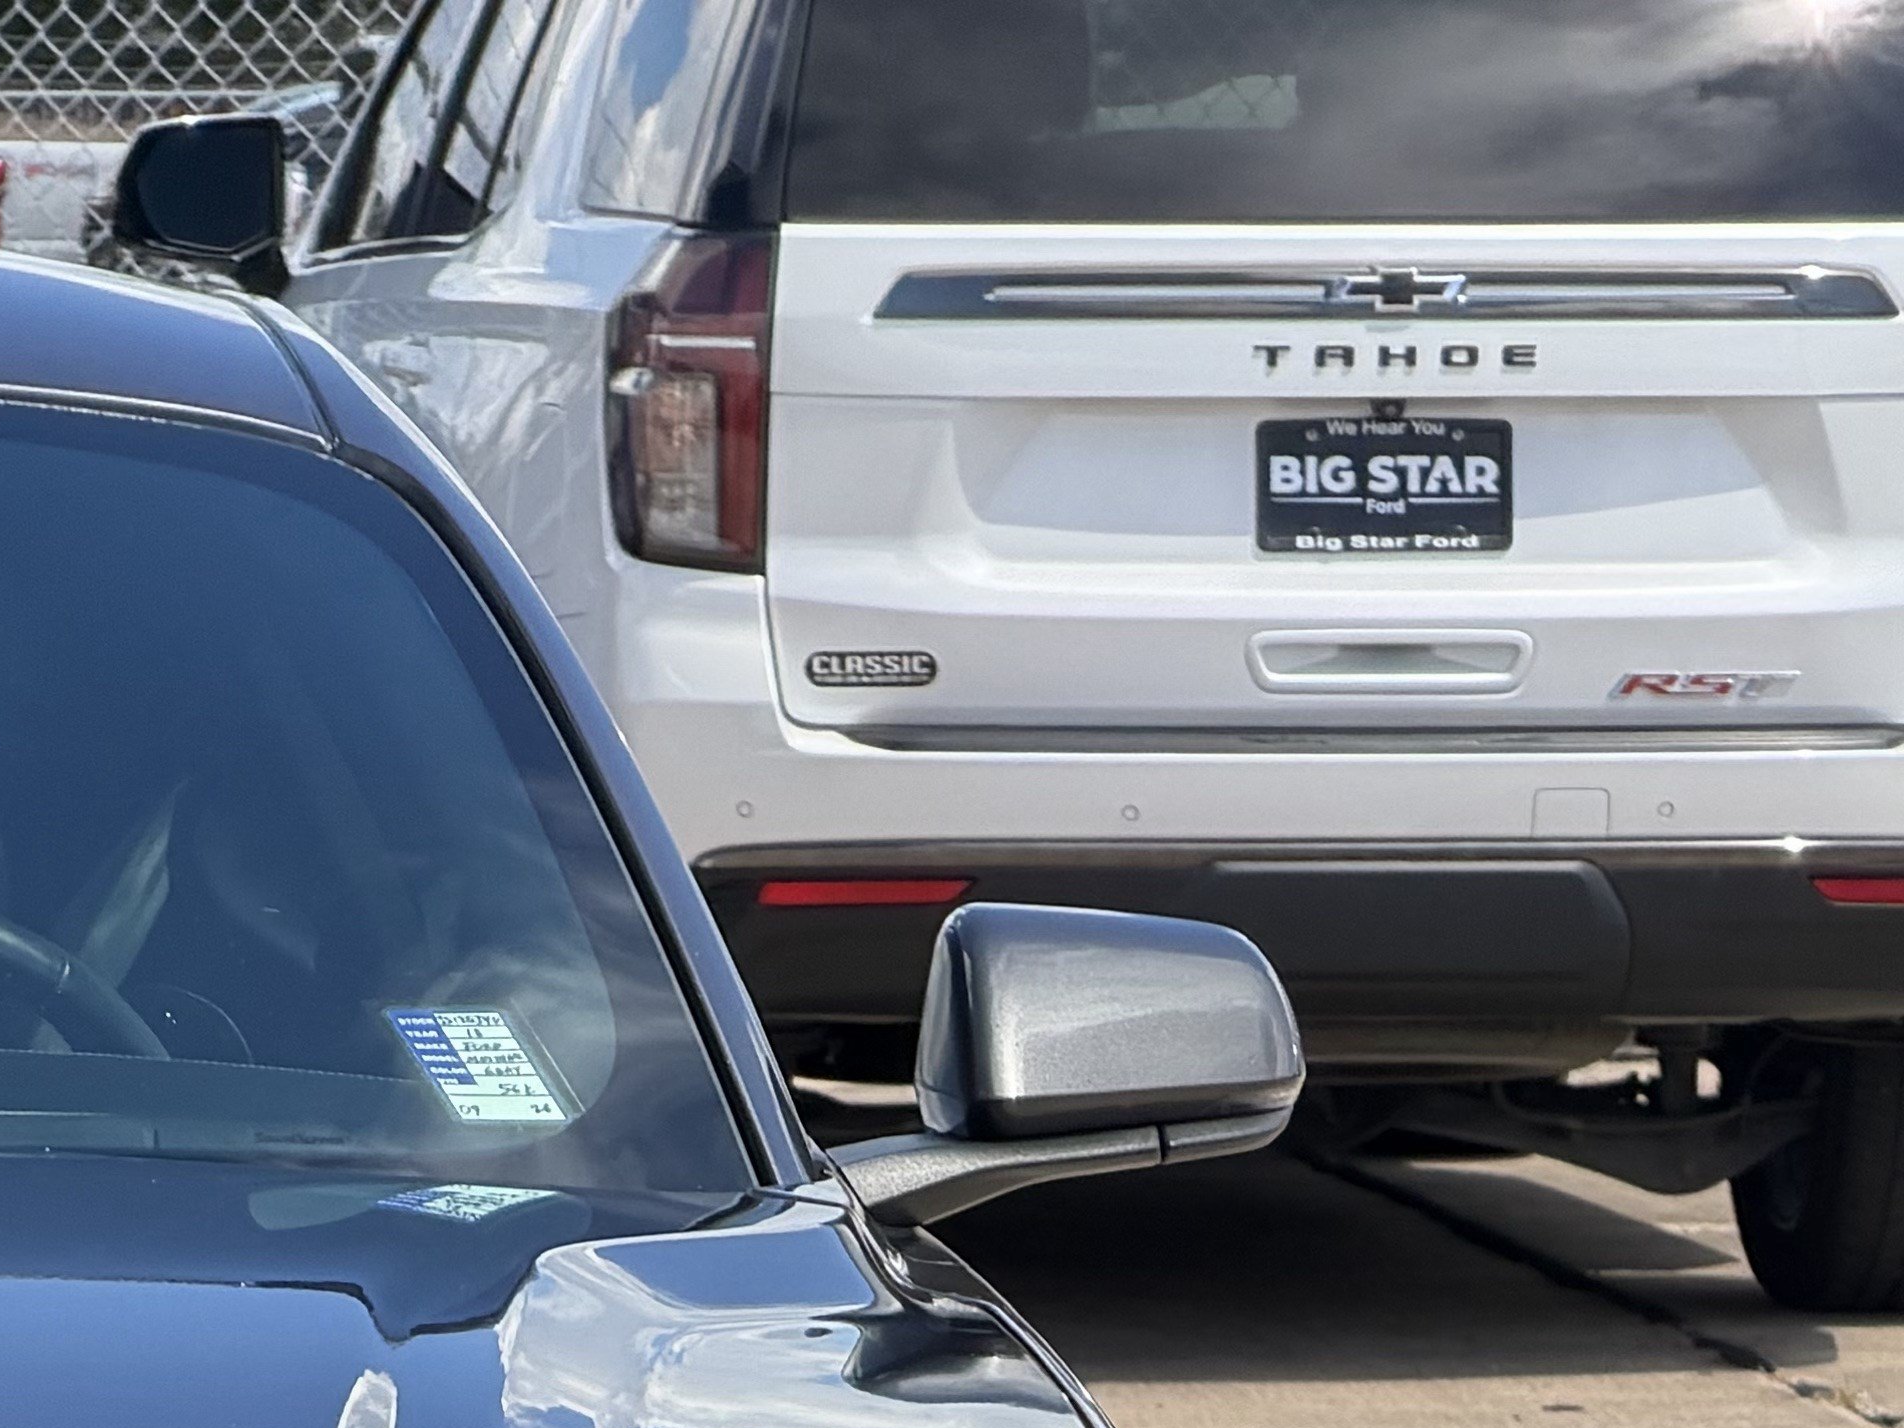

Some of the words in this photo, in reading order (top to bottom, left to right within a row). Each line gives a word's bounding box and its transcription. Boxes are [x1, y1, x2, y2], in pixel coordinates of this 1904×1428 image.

[1252, 345, 1537, 368] TAHOE
[1326, 420, 1357, 435] We
[1362, 420, 1407, 435] Hear
[1411, 420, 1446, 435] You
[1269, 455, 1356, 494] BIG
[1367, 455, 1501, 494] STAR
[1366, 499, 1406, 514] Ford
[1295, 535, 1342, 551] Big
[1350, 535, 1408, 549] Star
[1414, 535, 1480, 549] Ford
[812, 656, 930, 674] CLASSIC
